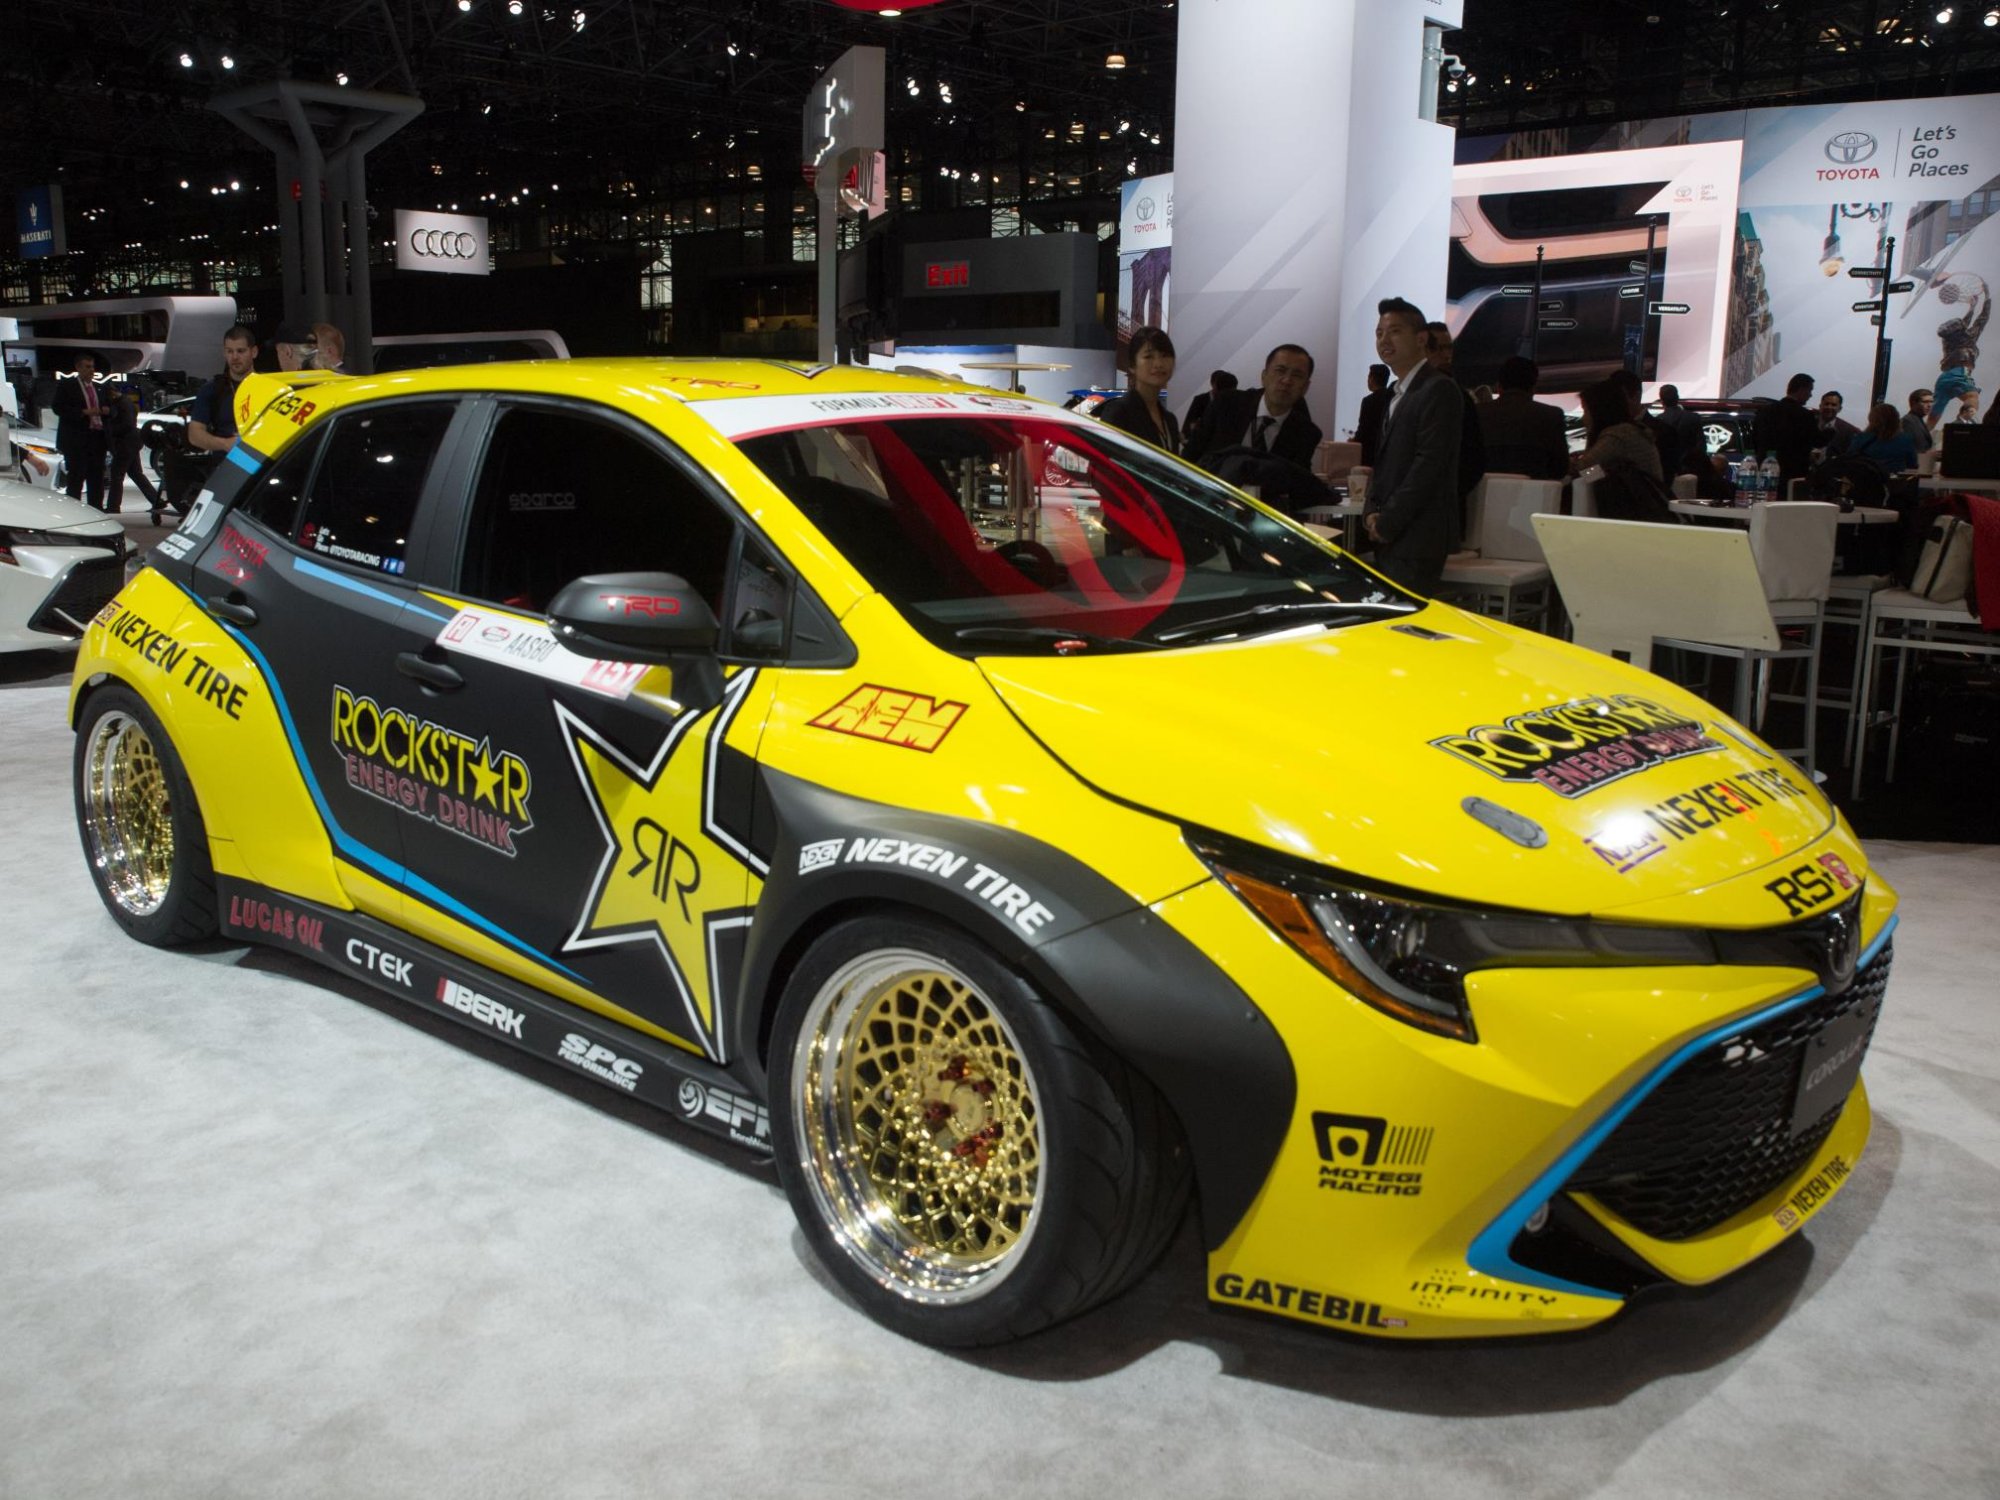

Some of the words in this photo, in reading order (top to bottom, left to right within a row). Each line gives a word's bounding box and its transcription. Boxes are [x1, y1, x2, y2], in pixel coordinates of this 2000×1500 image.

[1816, 168, 1880, 181] TOYOTA
[1908, 162, 1969, 177] Places
[1911, 145, 1939, 159] Go
[1134, 222, 1157, 234] TOYOTA
[927, 262, 969, 287] Exit
[55, 371, 128, 384] MRAI
[508, 492, 577, 507] sparco
[598, 593, 682, 618] TRD
[109, 609, 188, 674] NEXEN
[183, 655, 249, 721] TIRE
[805, 682, 970, 754] AEM
[1532, 739, 1648, 795] ENERGY
[1636, 726, 1722, 756] DRINK
[347, 753, 429, 813] ENERGY
[438, 792, 513, 851] DRINK
[1643, 778, 1763, 841] NEXEN
[844, 837, 968, 879] NEXEN
[964, 862, 1056, 936] TIRE
[229, 895, 295, 940] LUCAS
[296, 914, 325, 951] OIL
[346, 938, 414, 987] CTEK
[452, 982, 526, 1039] BERK
[557, 1047, 637, 1092] PERFORMANCE
[560, 1032, 644, 1080] SPC
[1318, 1178, 1422, 1196] RACING
[1319, 1165, 1422, 1183] MOTEGI
[1790, 1173, 1831, 1216] NEXEN
[1821, 1155, 1850, 1185] TIRE
[1214, 1272, 1389, 1329] GATEBIL
[1410, 1280, 1557, 1306] INFINITY
